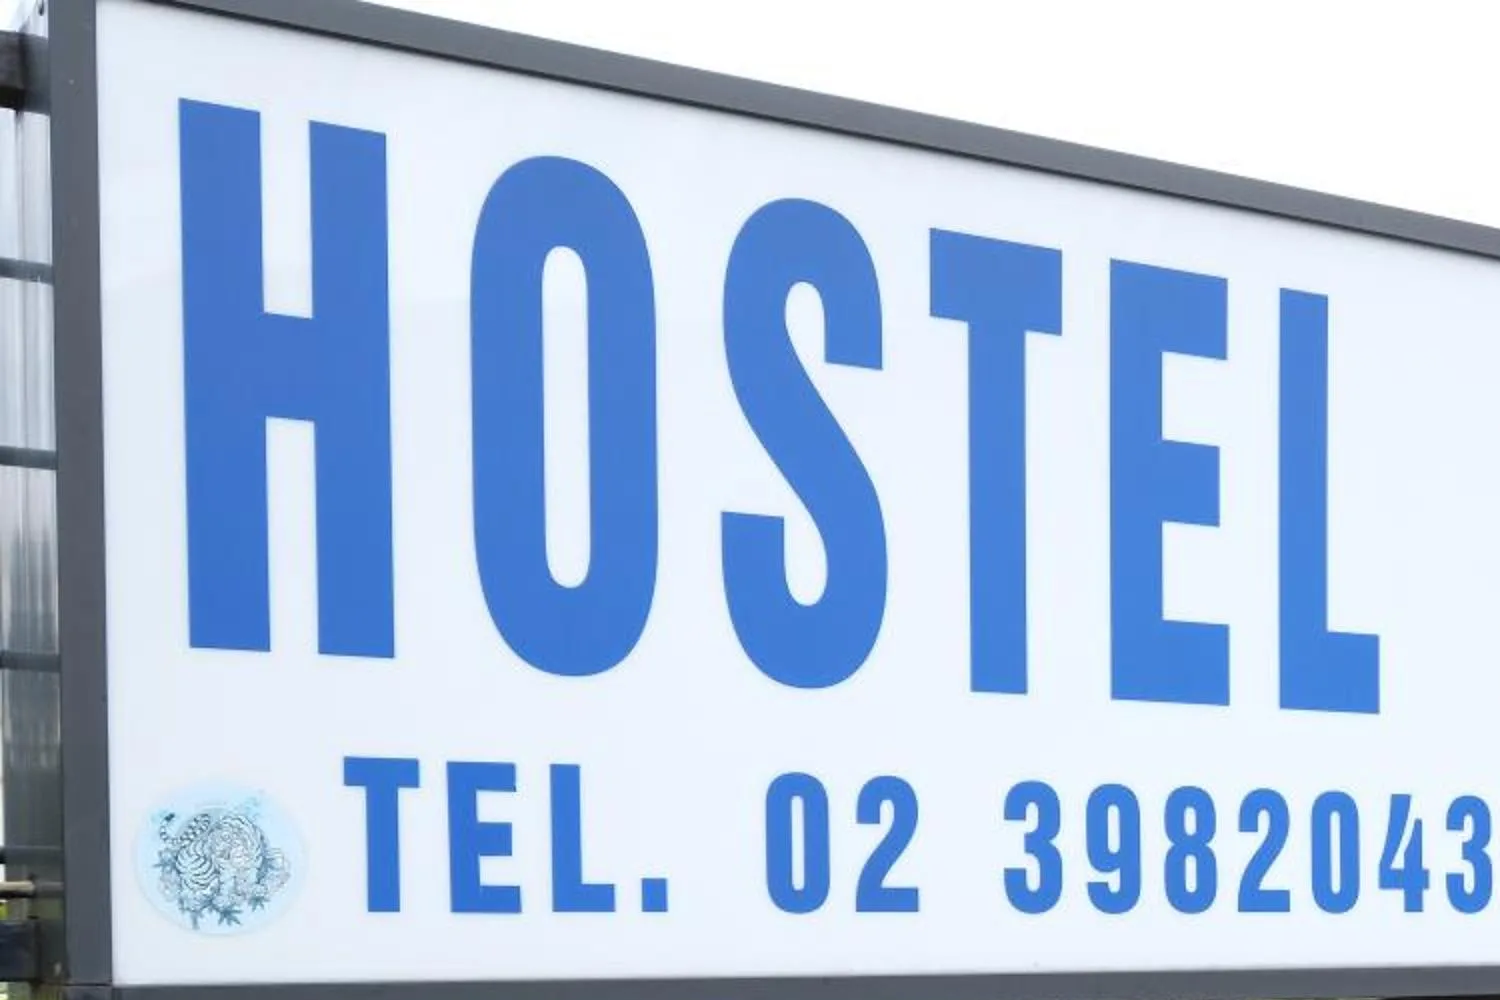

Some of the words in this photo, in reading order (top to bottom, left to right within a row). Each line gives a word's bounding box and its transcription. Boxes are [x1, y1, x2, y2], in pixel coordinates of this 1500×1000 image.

[178, 97, 1381, 714] HOSTEL
[343, 756, 668, 914] TEL.
[766, 772, 919, 914] 02
